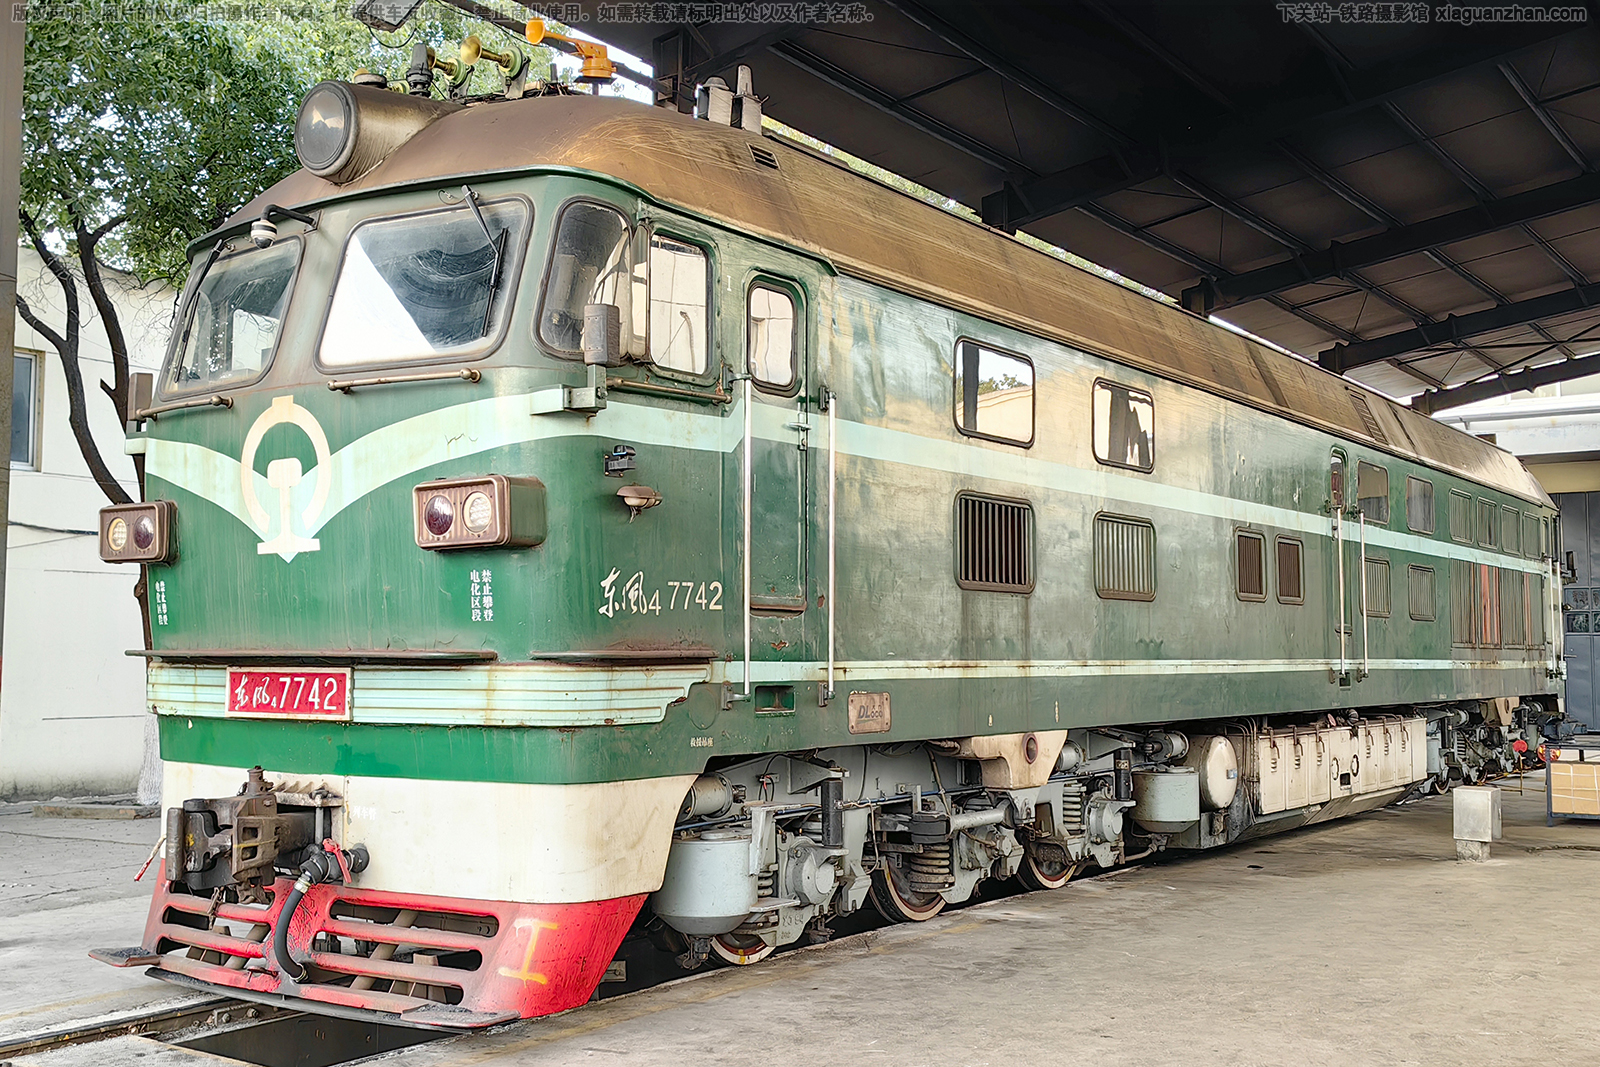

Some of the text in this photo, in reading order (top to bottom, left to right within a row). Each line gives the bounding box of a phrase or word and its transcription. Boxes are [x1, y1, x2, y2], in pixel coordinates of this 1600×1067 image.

[470, 569, 482, 621] 电化区段
[481, 569, 494, 621] 禁止攀登
[667, 581, 723, 610] 7742
[278, 677, 338, 711] 7742
